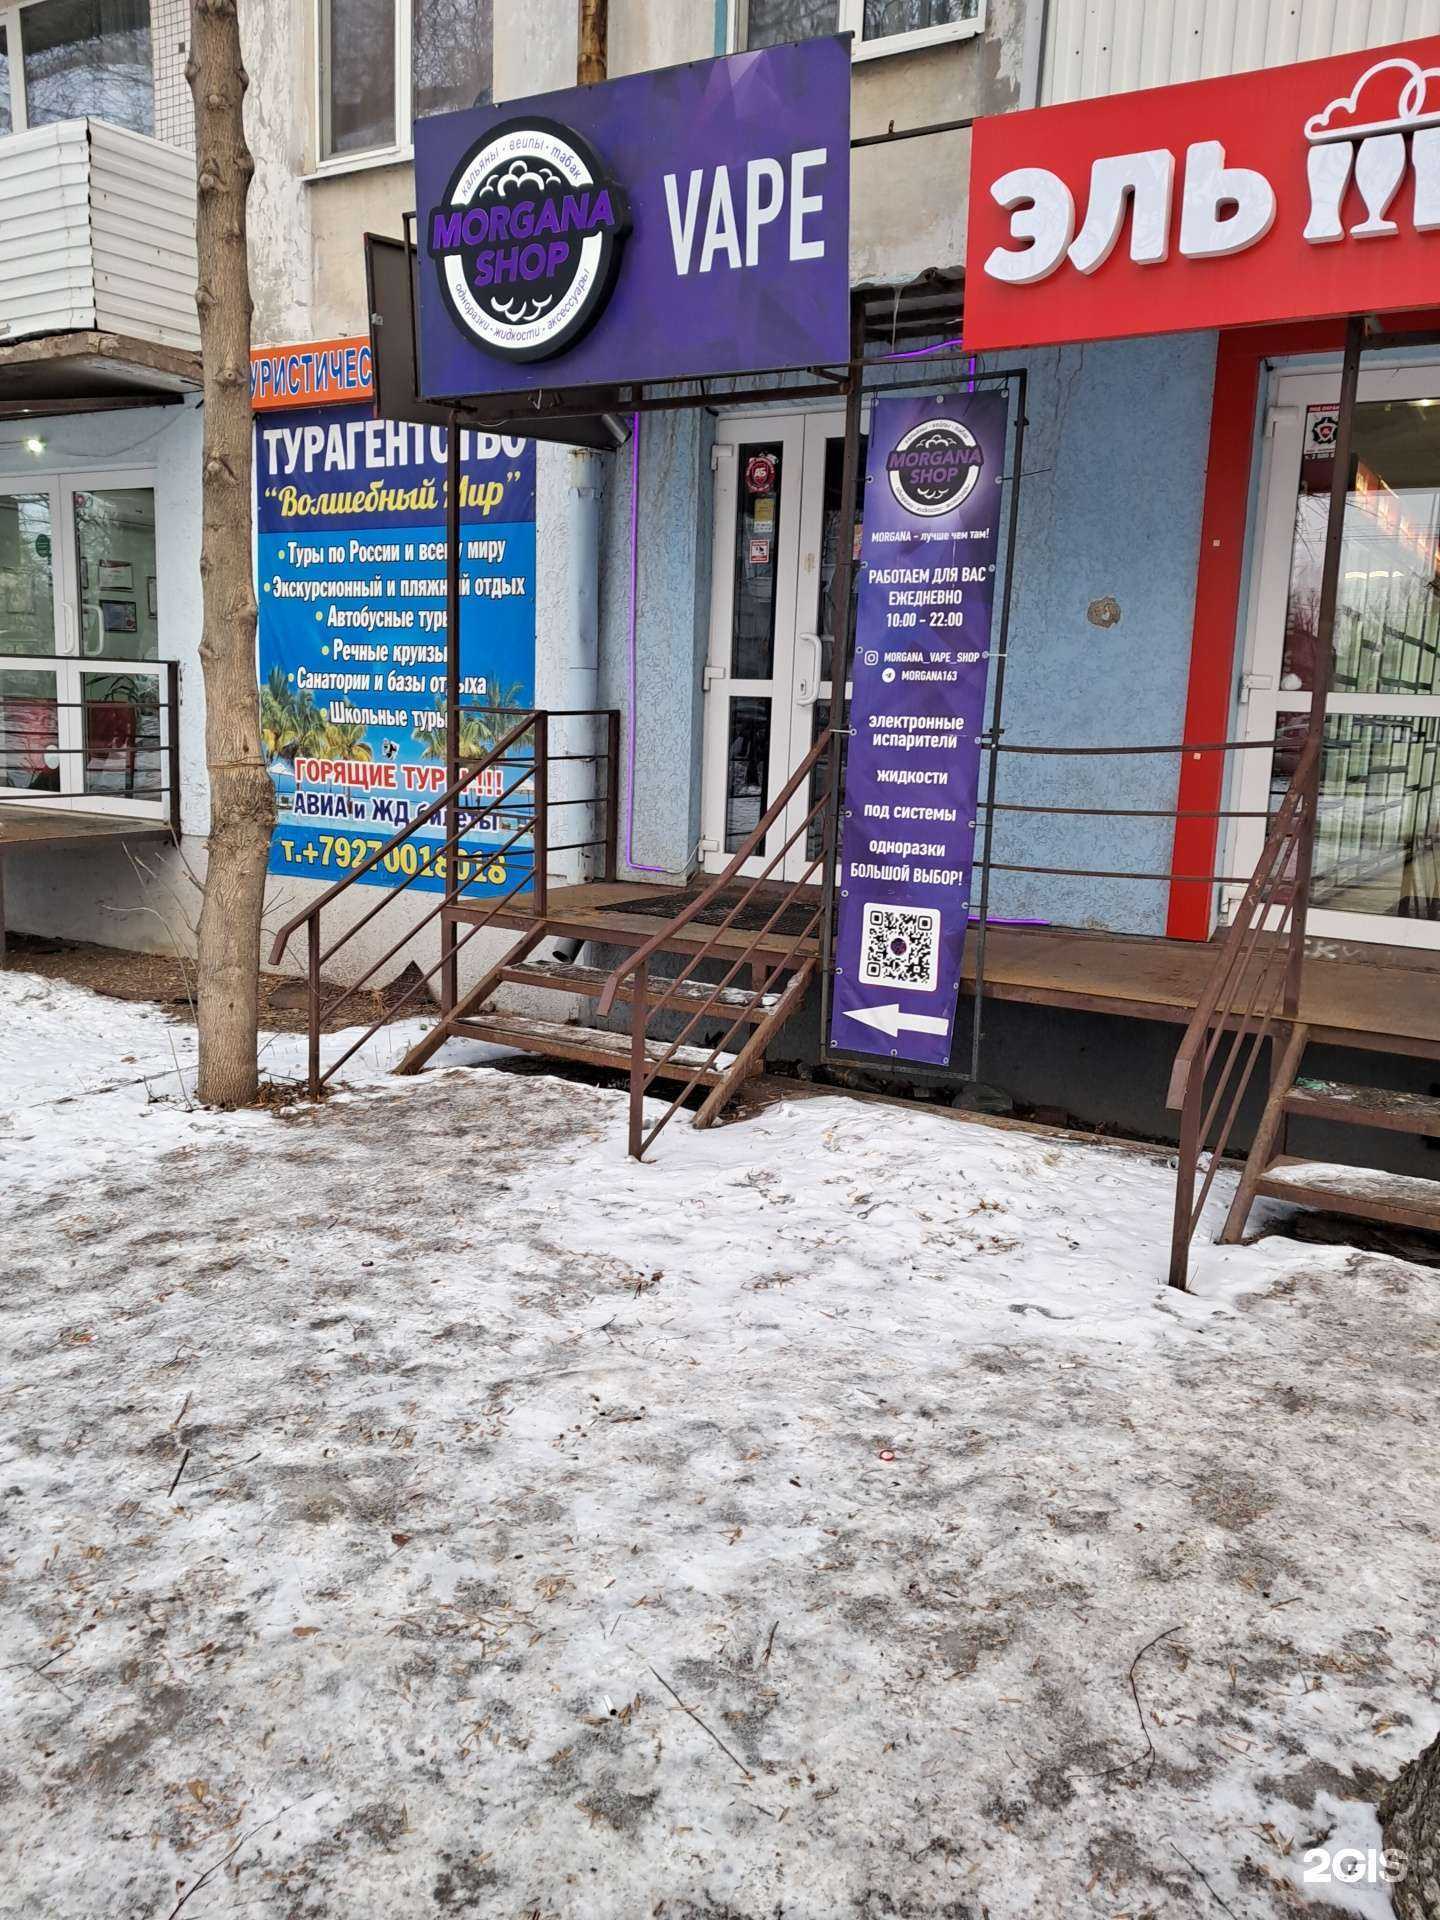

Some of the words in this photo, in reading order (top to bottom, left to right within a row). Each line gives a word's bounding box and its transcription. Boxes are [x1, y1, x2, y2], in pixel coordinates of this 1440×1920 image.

[461, 148, 499, 197] кальяны
[550, 146, 582, 180] табак
[432, 190, 615, 249] MORGANA
[663, 147, 828, 276] VAPE
[474, 241, 570, 287] SHOP
[493, 327, 540, 341] жидкости
[547, 268, 590, 330] аксессуары
[889, 448, 982, 468] MORGANA
[910, 467, 959, 484] SHOP
[871, 531, 912, 543] MORGANA
[920, 532, 950, 543] лучше
[951, 531, 968, 540] чем
[970, 527, 990, 539] там!
[288, 541, 324, 568] Туры
[329, 545, 344, 564] по
[350, 539, 400, 563] России
[405, 544, 414, 561] и
[468, 539, 506, 565] миру
[868, 569, 930, 584] РАБОТАЕМ
[932, 567, 958, 584] ДЛЯ
[961, 566, 987, 582] ВАС
[273, 575, 382, 601] Экскурсионный
[387, 579, 396, 597] и
[400, 574, 470, 598] пляжнй
[474, 576, 526, 598] отдых
[888, 589, 963, 607] ЕЖЕДНЕВНО
[327, 604, 414, 631] Автобусные
[886, 612, 917, 627] 10:00
[929, 611, 964, 627] 22:00
[333, 638, 388, 662] Речные
[297, 666, 370, 694] Санатории
[374, 674, 383, 691] и
[387, 669, 426, 694] базы
[430, 676, 487, 695] отыха
[901, 670, 958, 681] MORGANA163
[330, 701, 408, 727] Школьные
[868, 715, 965, 732] электронные
[872, 733, 958, 751] испарители
[294, 758, 397, 791] ГОРЯЩИЕ
[876, 769, 949, 785] жидкости
[294, 792, 350, 818] АВИА
[354, 802, 366, 820] и
[371, 799, 410, 827] ЖД
[863, 804, 890, 819] под
[893, 805, 957, 821] системы
[869, 839, 946, 858] одноразки
[850, 862, 910, 882] БОЛЬШОЙ
[913, 867, 963, 886] ВЫБОР!
